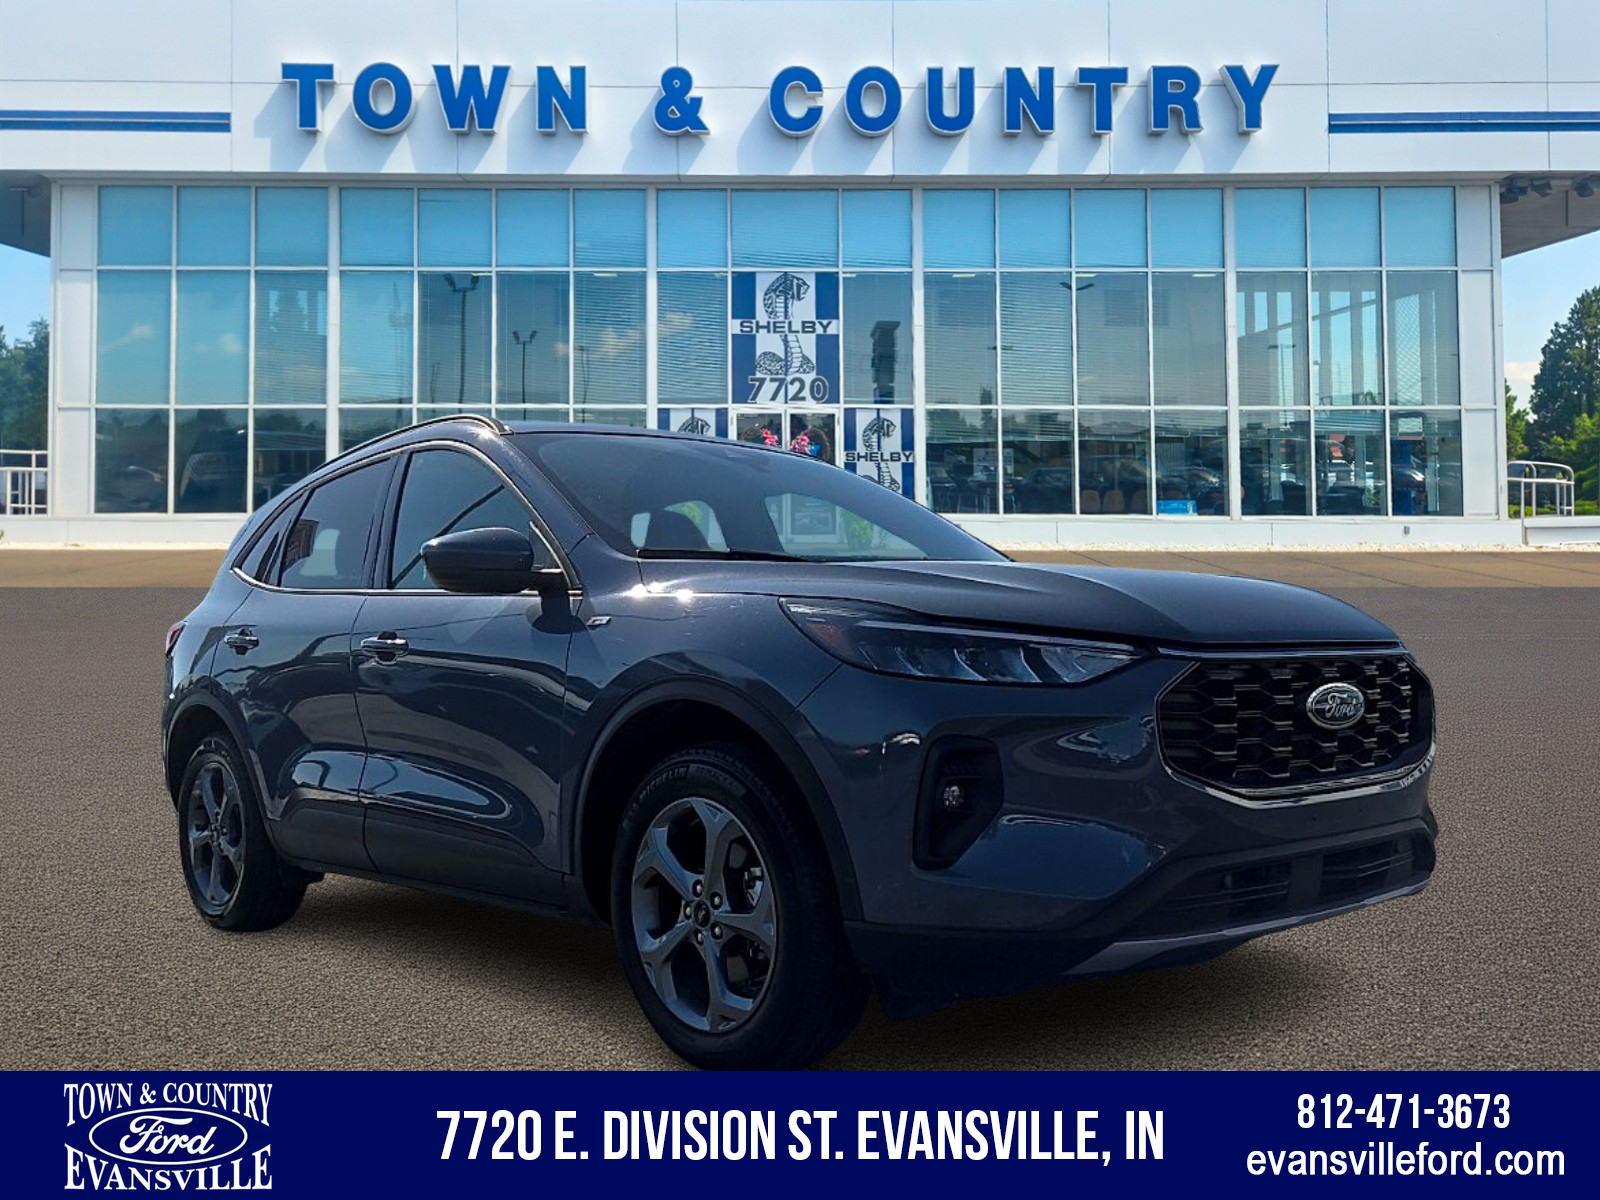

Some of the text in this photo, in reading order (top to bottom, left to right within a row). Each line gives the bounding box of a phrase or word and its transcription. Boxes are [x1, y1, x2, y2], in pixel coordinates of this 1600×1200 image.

[281, 62, 1280, 137] TOWN & COUNTRY
[739, 320, 833, 334] SHELBY
[748, 376, 829, 404] 7720
[845, 451, 913, 462] SHELBY
[1324, 692, 1359, 718] Ford
